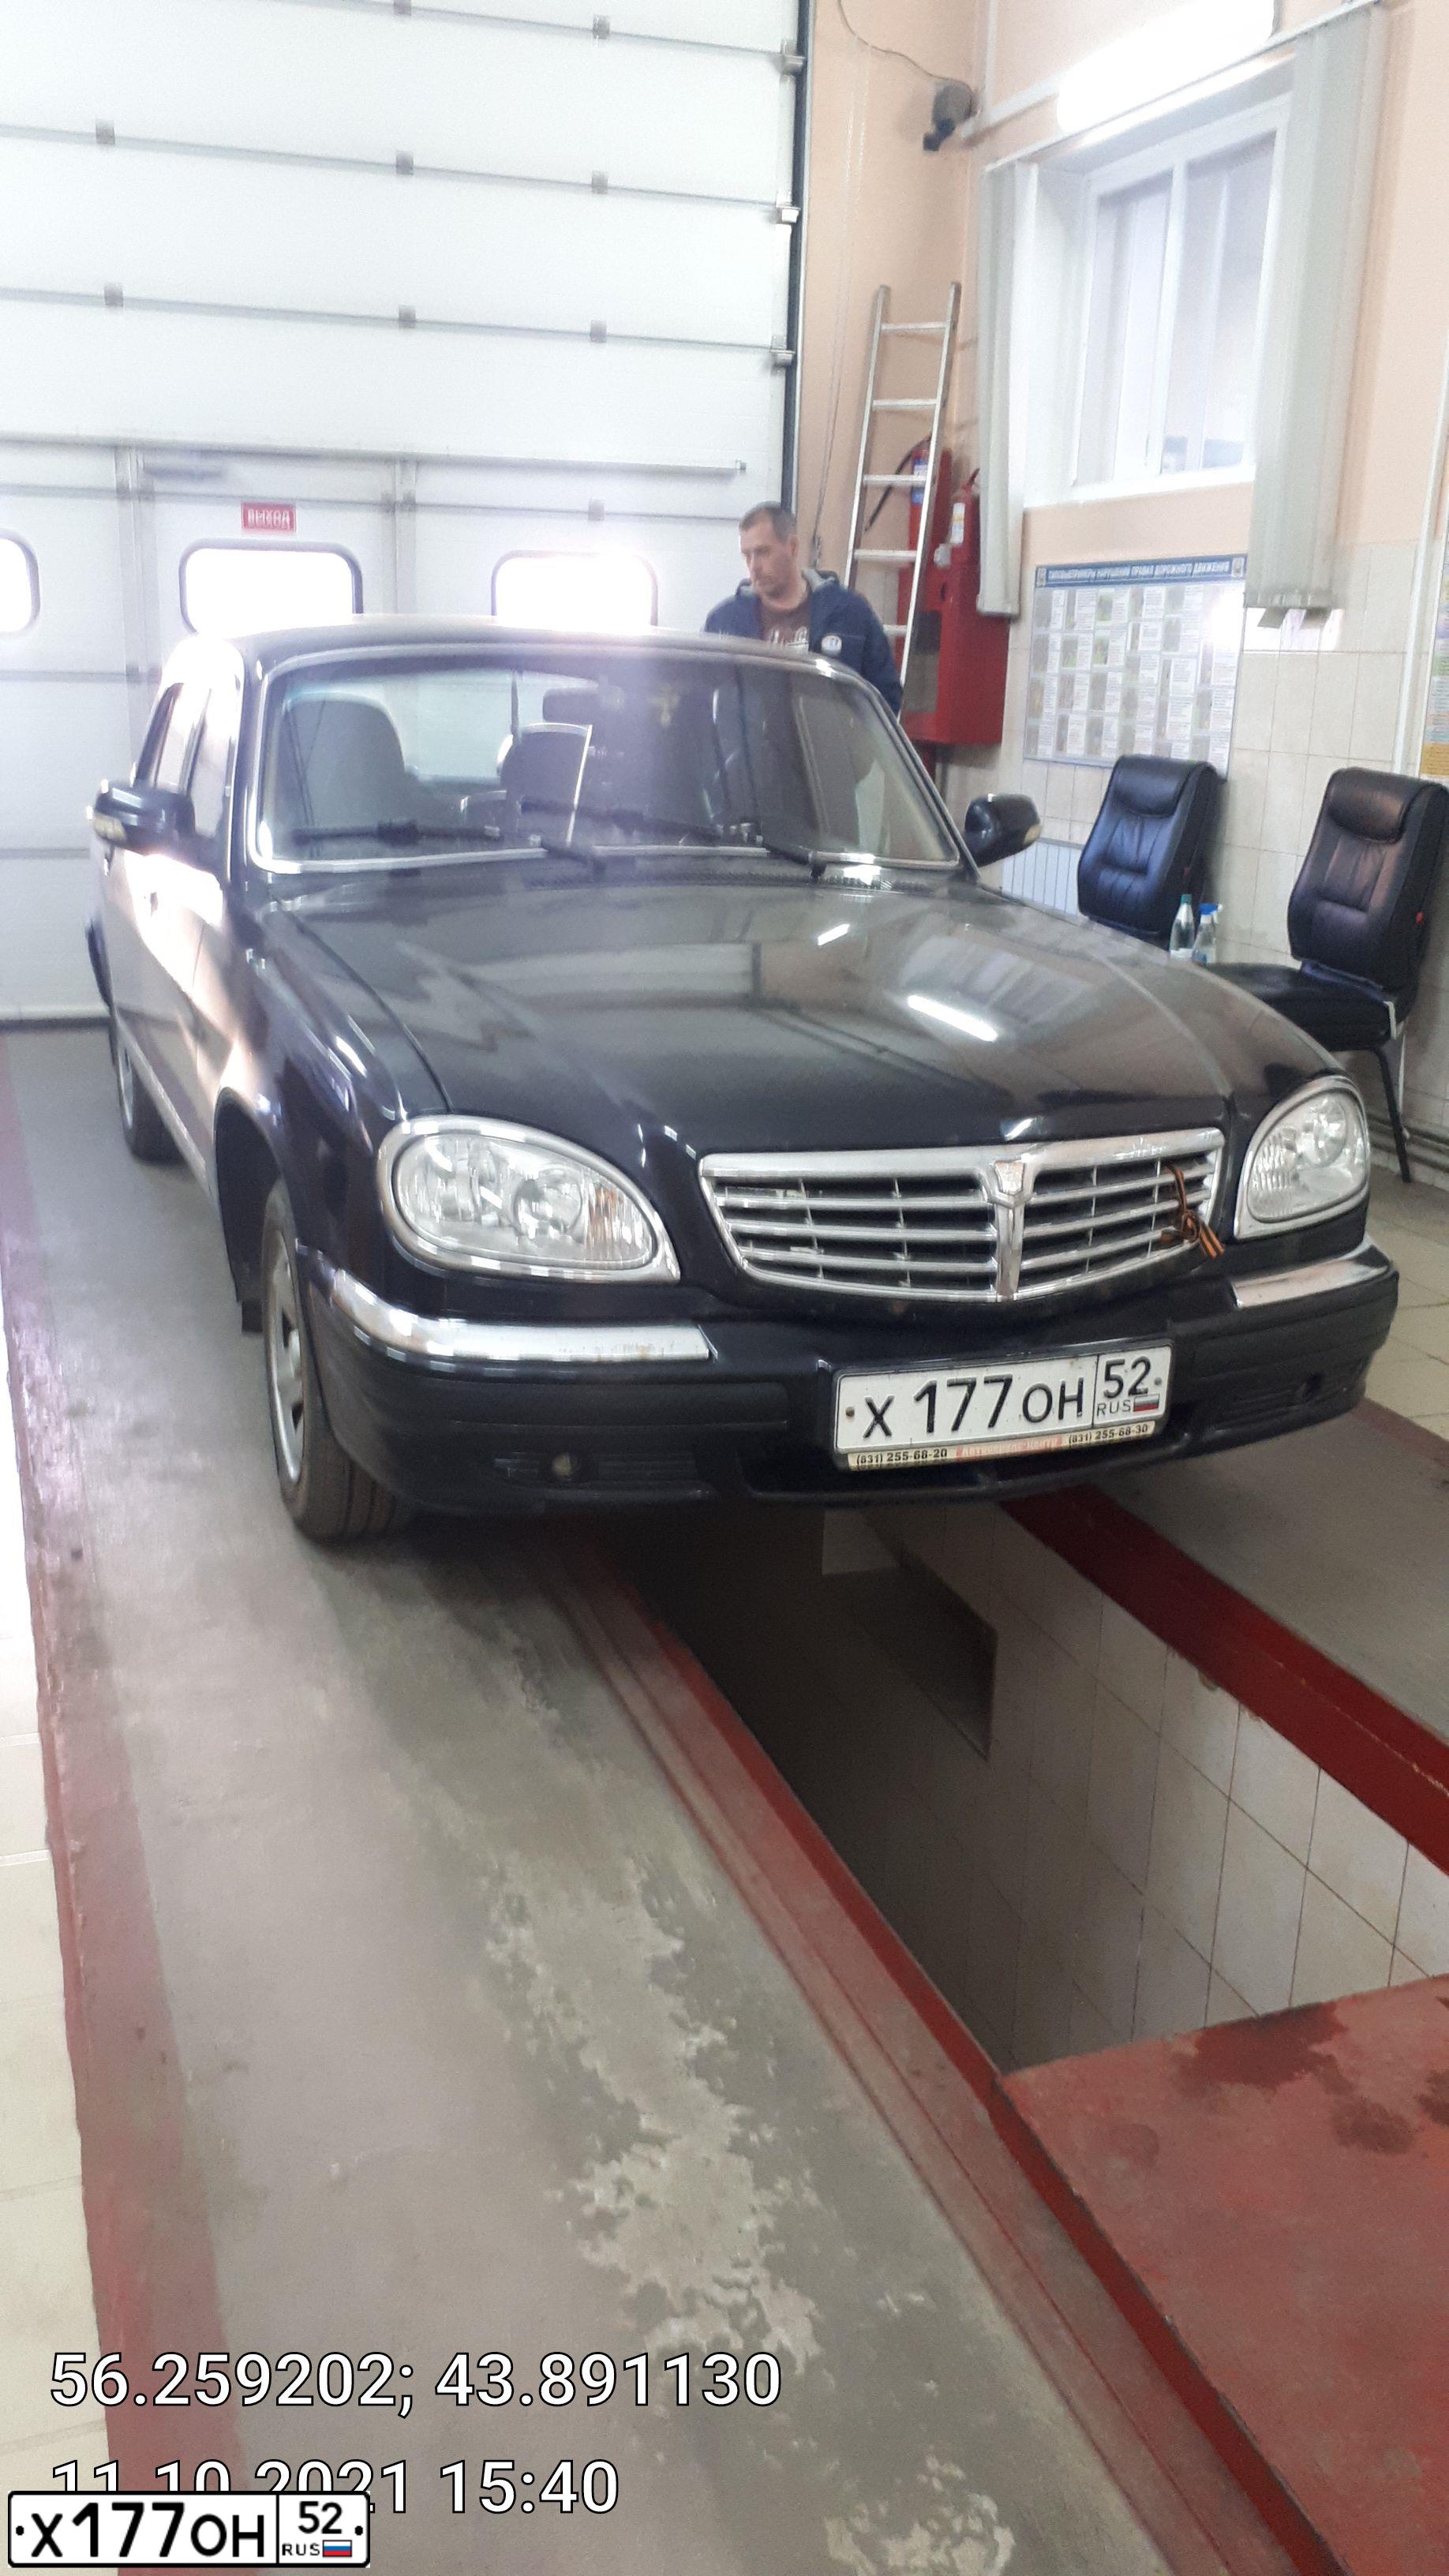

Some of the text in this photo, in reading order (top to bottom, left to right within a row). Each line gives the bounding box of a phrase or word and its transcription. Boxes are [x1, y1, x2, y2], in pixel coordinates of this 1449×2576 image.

[1103, 1355, 1151, 1398] 52
[1096, 1399, 1132, 1417] RUS
[856, 1454, 883, 1465] (831)
[1069, 1432, 1092, 1444] (831)
